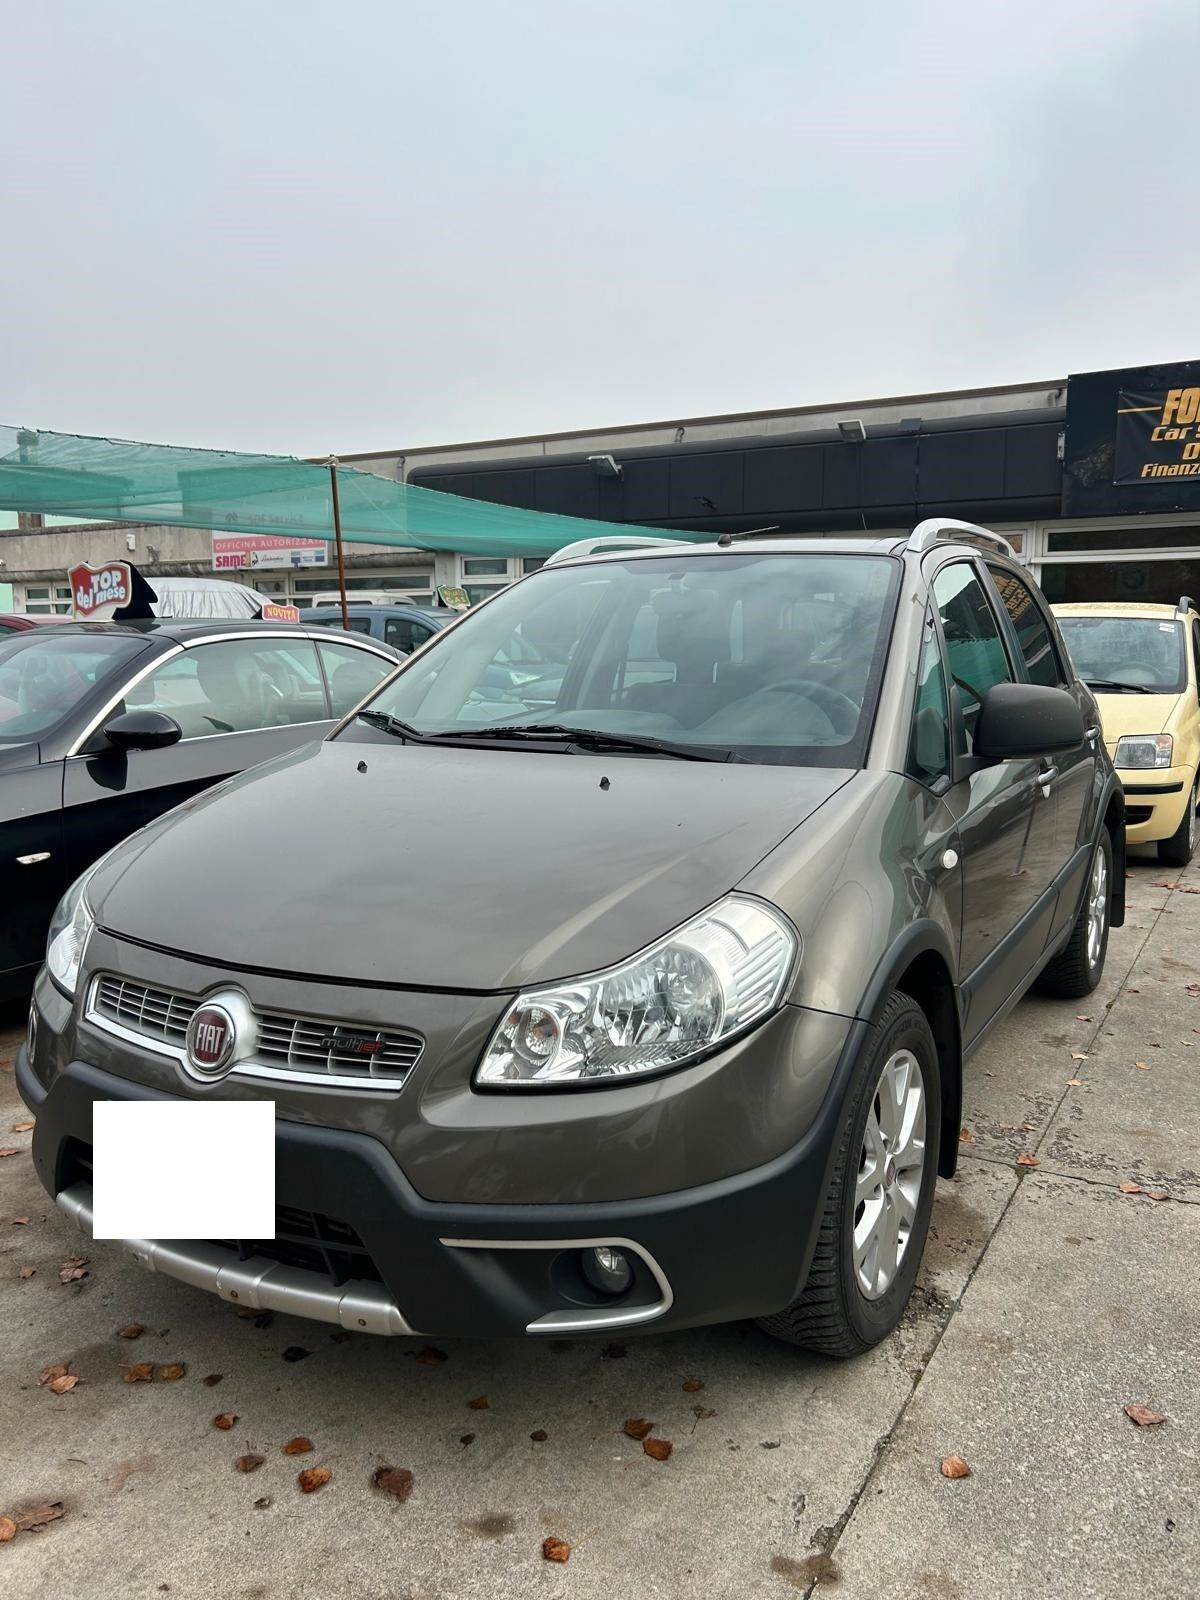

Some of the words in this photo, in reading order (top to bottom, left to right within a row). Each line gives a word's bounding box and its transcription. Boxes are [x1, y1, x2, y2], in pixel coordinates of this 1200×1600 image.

[1161, 387, 1200, 426] FO
[1151, 426, 1193, 441] Car
[1182, 442, 1200, 460] O
[1141, 463, 1200, 477] Finanz
[215, 539, 257, 551] OFFICINA
[215, 554, 246, 568] SAME
[90, 570, 122, 594] TOP
[76, 586, 93, 609] del
[95, 586, 126, 605] mese
[196, 1022, 225, 1055] FIAT
